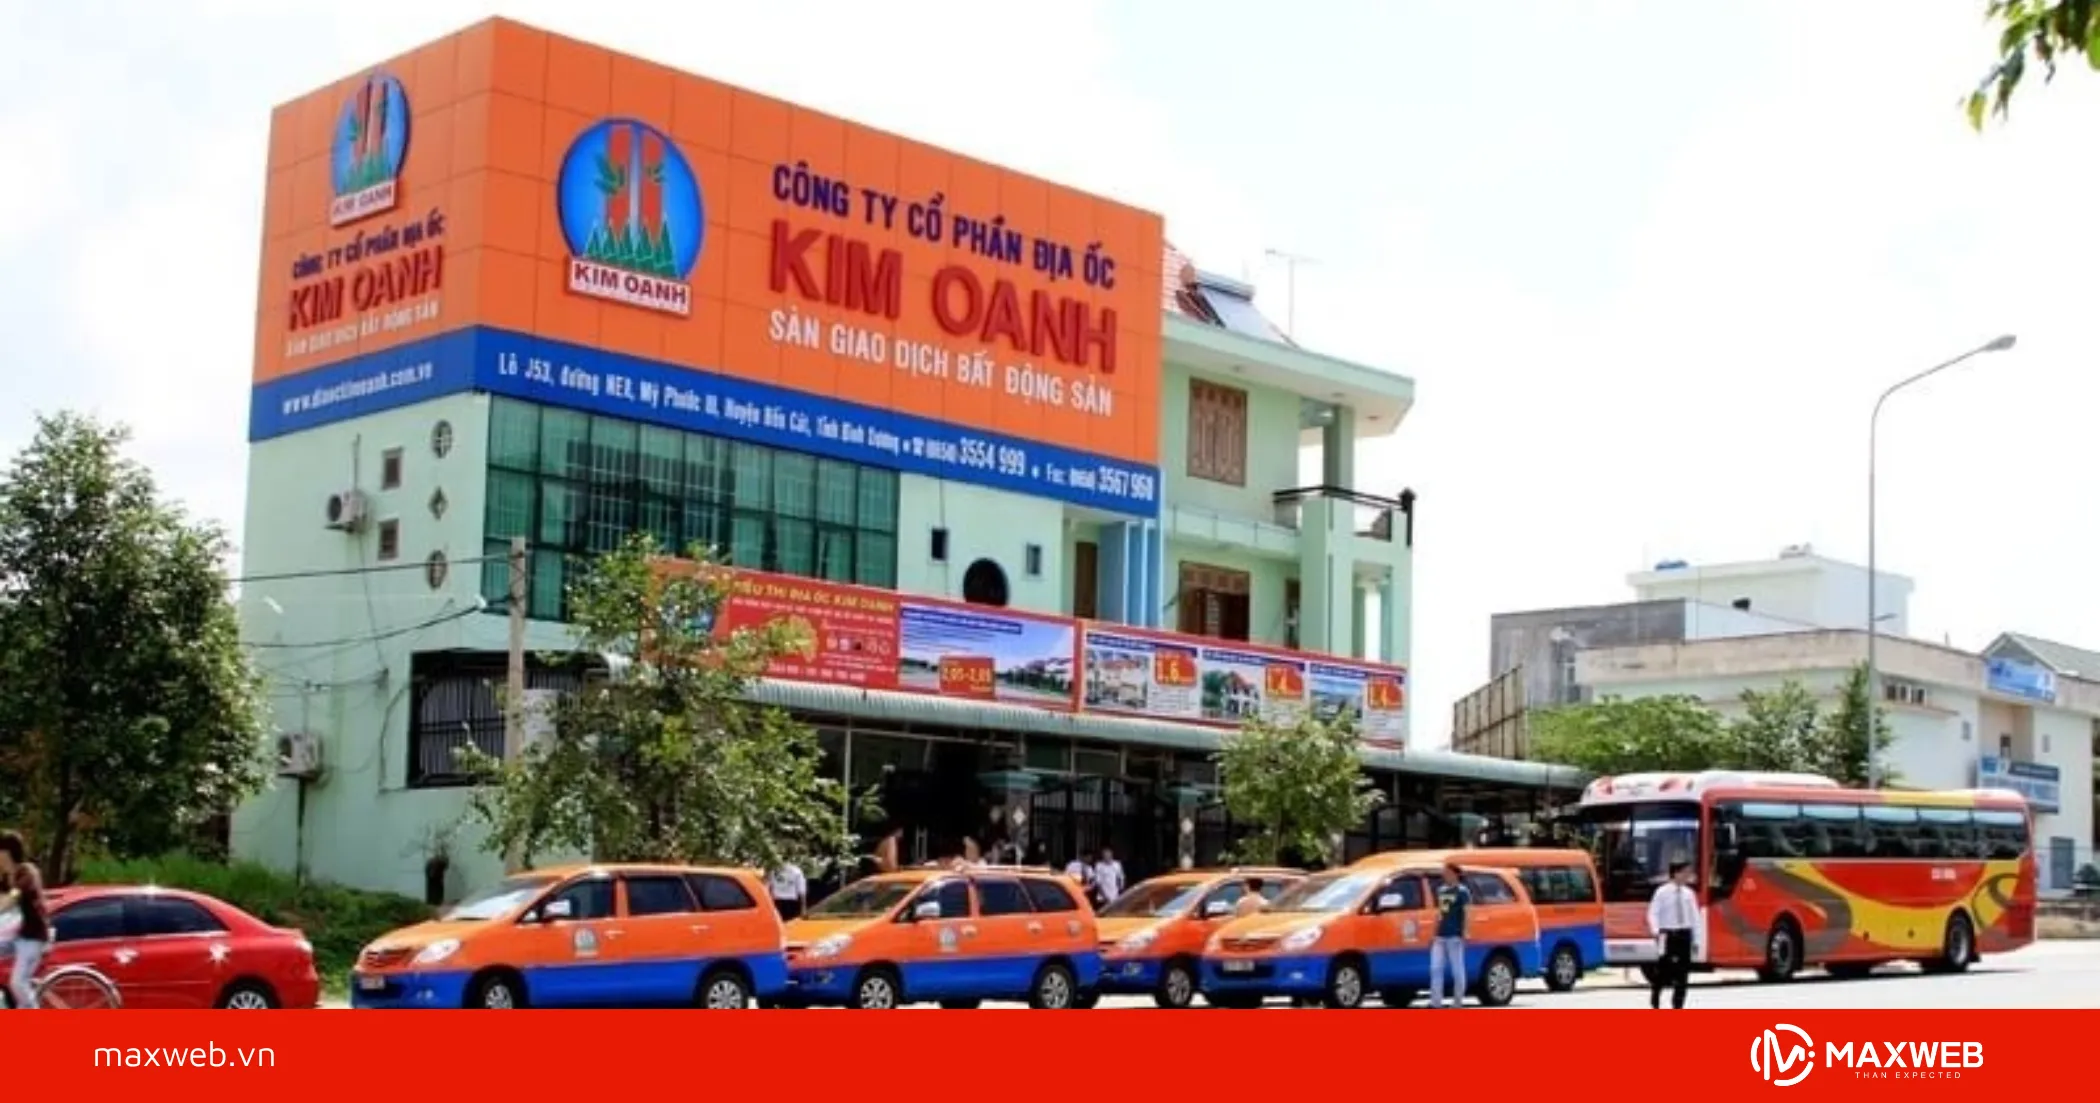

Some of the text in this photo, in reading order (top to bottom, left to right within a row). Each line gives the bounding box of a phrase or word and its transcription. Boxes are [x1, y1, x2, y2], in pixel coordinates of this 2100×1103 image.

[773, 160, 849, 218] CÔNG
[861, 189, 898, 230] TY
[908, 191, 944, 241] CỔ
[1033, 238, 1073, 282] ĐỊA
[1083, 240, 1115, 290] ỐC
[289, 245, 443, 331] KIM OANH
[575, 263, 686, 304] KIM OANH
[769, 219, 1116, 374] KIM OANH
[499, 351, 518, 375] Lô
[830, 324, 886, 364] GIAO
[895, 339, 948, 377] DỊCH
[957, 349, 995, 388] BẤT
[1005, 362, 1064, 405] ĐỘNG
